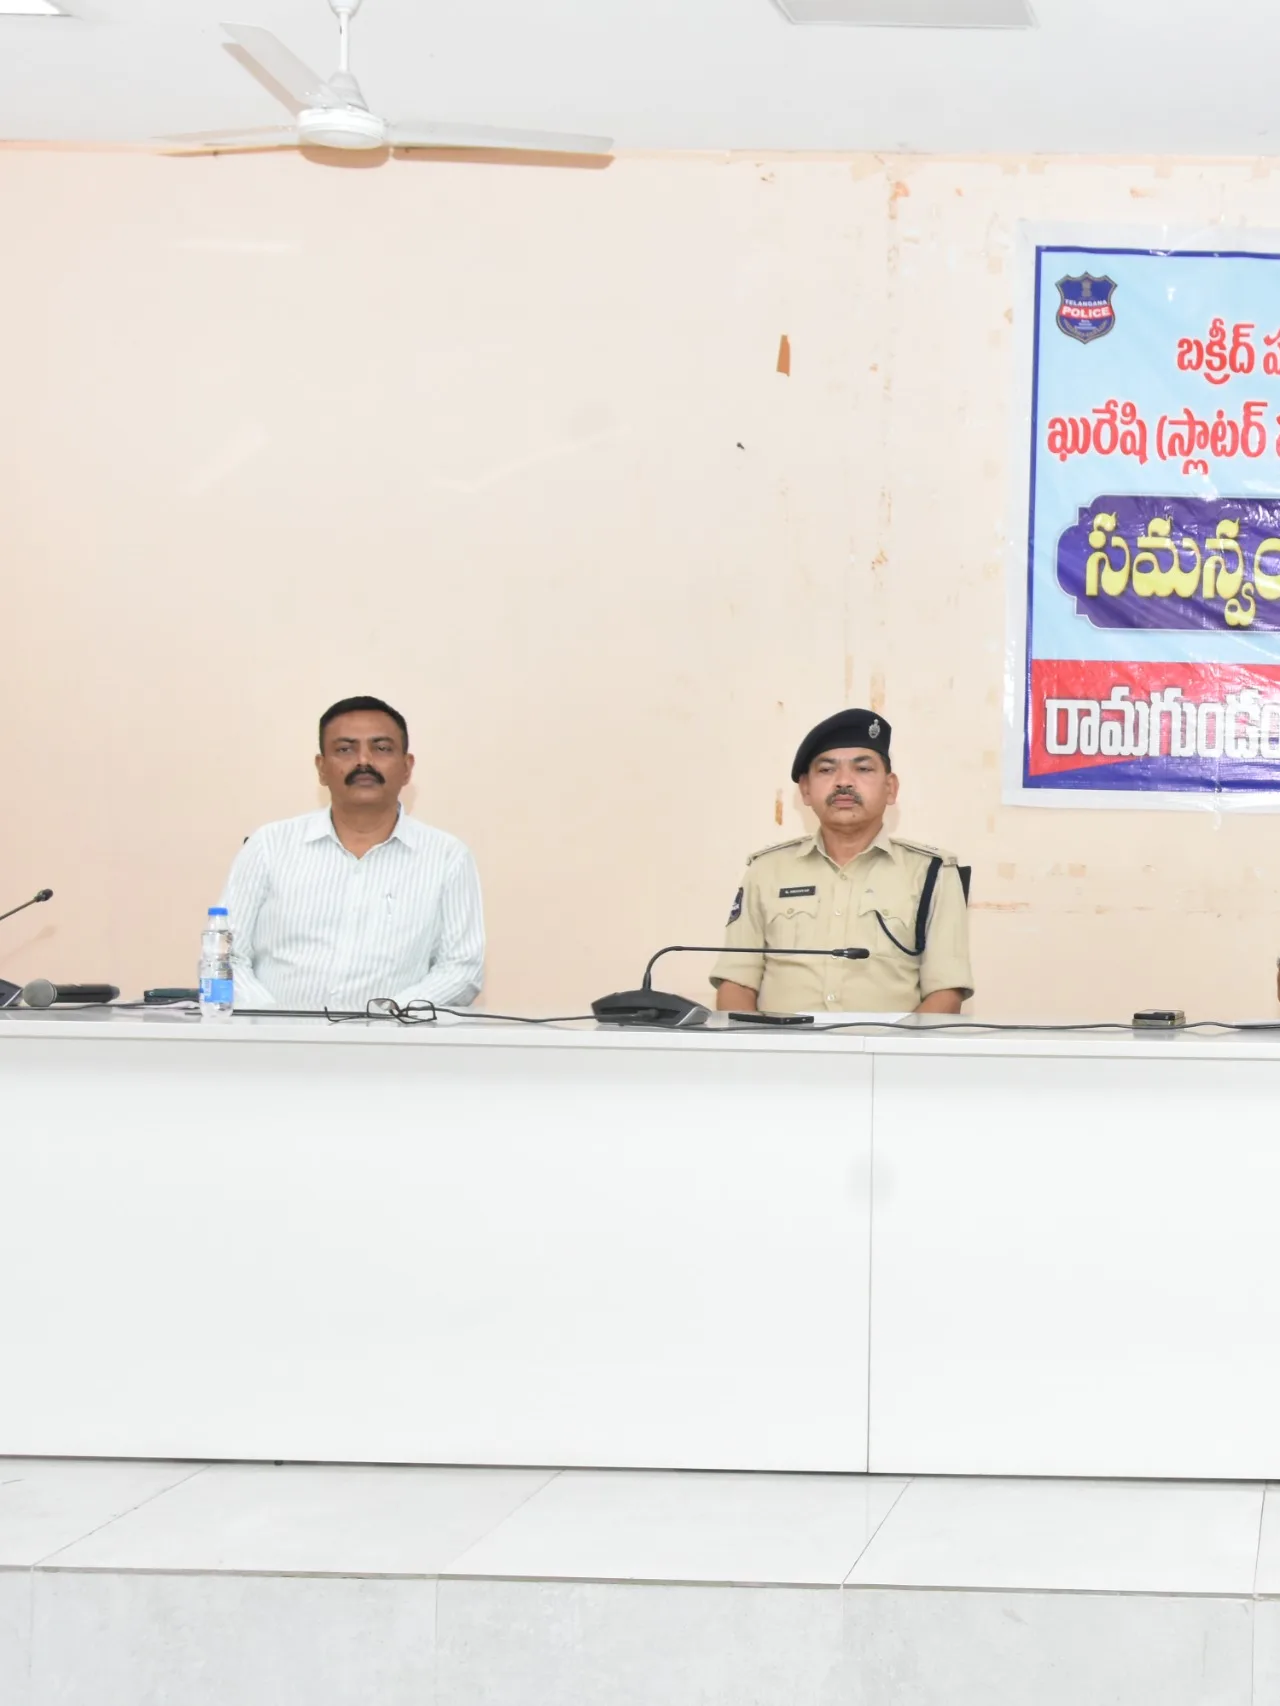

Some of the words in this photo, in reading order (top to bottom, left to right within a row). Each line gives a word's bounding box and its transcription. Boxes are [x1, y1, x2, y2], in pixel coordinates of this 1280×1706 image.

[1062, 305, 1110, 318] POLICE
[1177, 317, 1256, 386] బక్రీద్
[1047, 399, 1149, 466] ఖురేషి
[1156, 401, 1268, 476] (స్లాటర్
